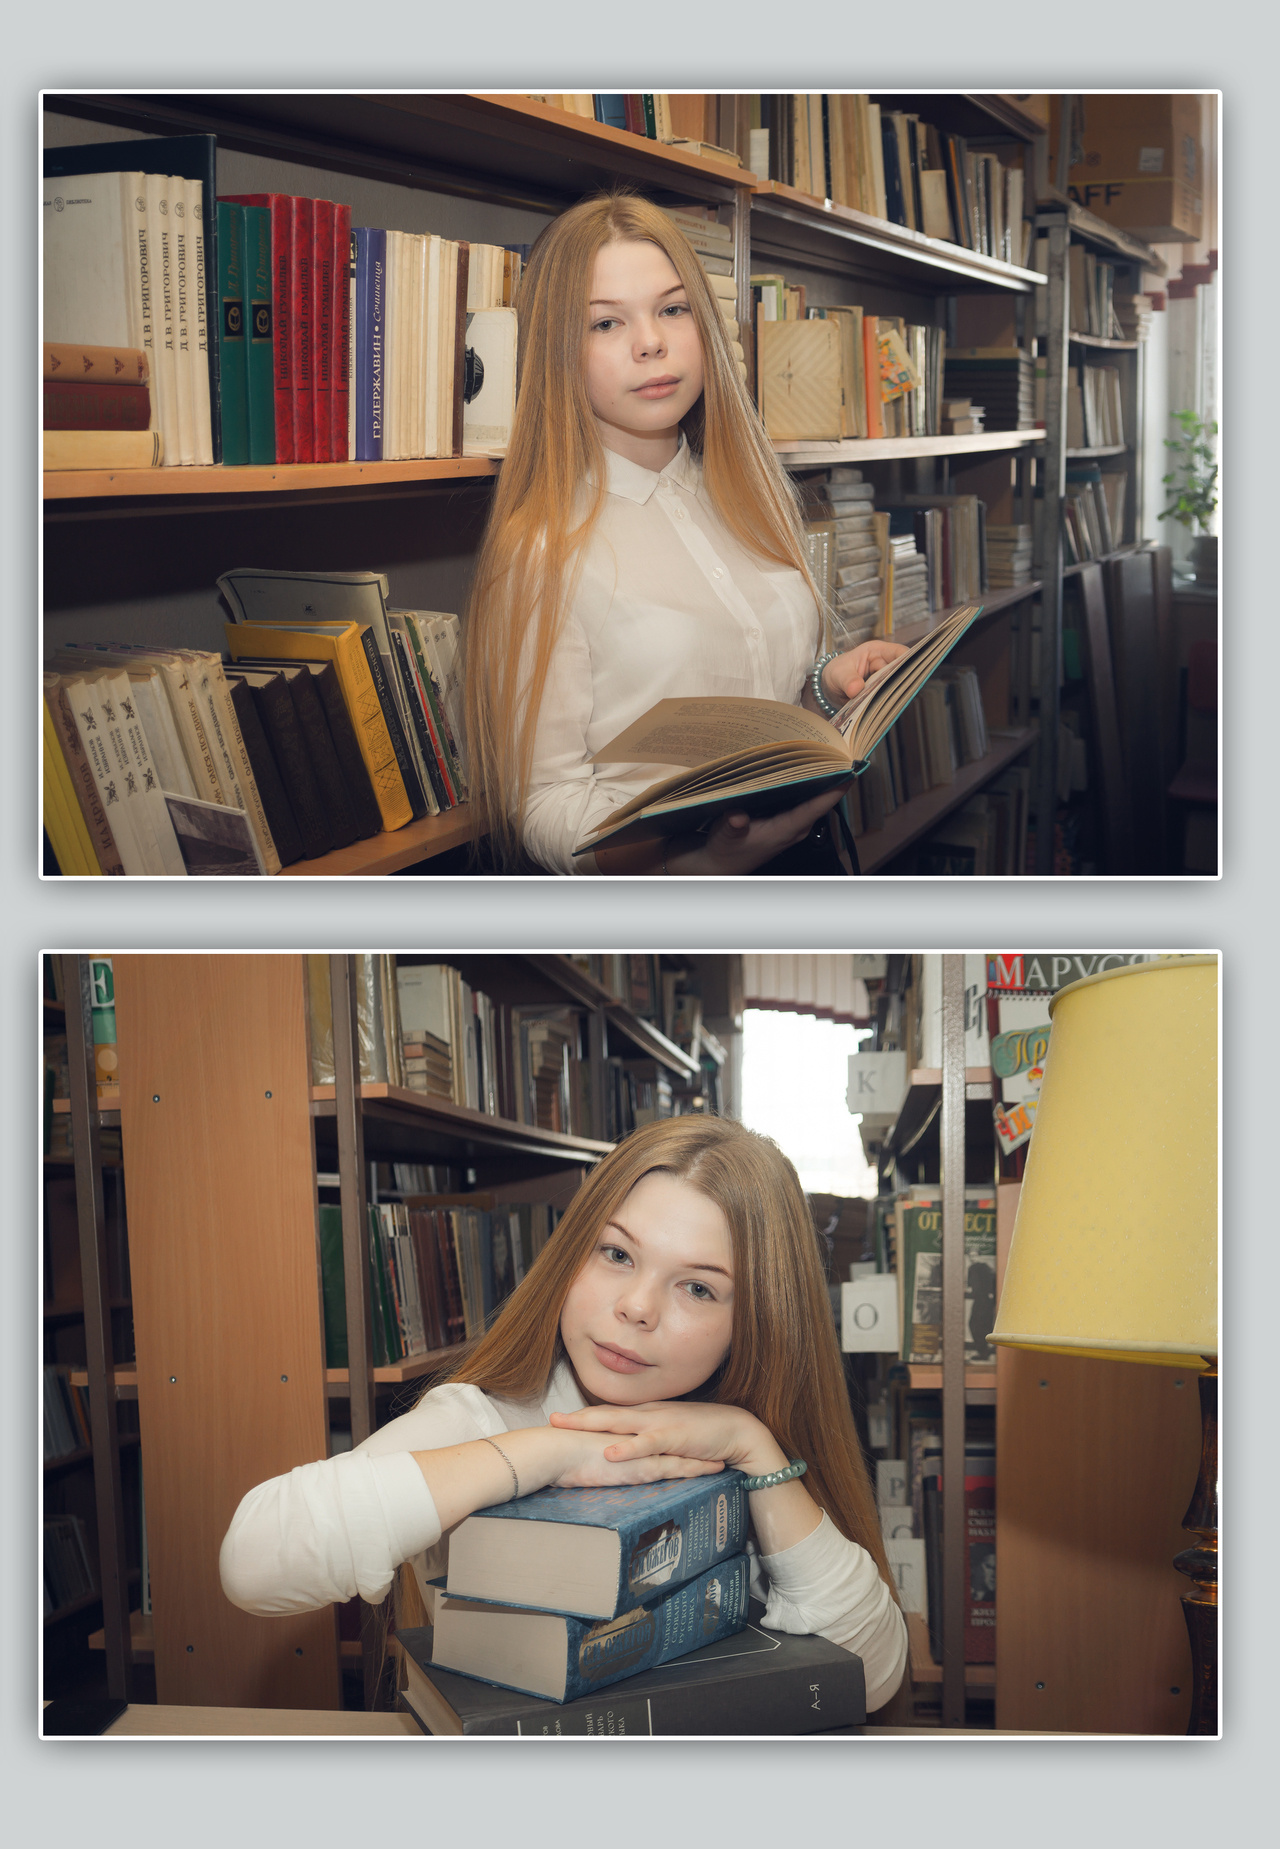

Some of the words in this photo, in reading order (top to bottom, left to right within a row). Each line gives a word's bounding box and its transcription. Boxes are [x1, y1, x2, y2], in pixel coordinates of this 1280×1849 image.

[138, 229, 151, 319] ГРИГОРОВИЧ
[161, 231, 172, 321] ГРИГОРОВИЧ
[177, 234, 187, 323] ГРИГОРОВИЧ
[196, 235, 205, 323] ГРИГОРОВИЧ
[278, 255, 290, 315] ГУМИЛЕВ
[322, 260, 330, 318] ГУМИЛЕВ
[372, 261, 382, 322] Сочинения
[276, 318, 289, 380] НИКОЛАЙ
[298, 321, 308, 381] НИКОЛАЙ
[321, 322, 329, 381] НИКОЛАЙ
[362, 636, 386, 692] Рассказы
[112, 726, 130, 765] ИЗБРАННОЕ
[131, 723, 149, 761] ИЗБРАННОЕ
[185, 697, 209, 751] ПОЕДИНОК
[93, 734, 112, 774] ИЗБРАННОЕ
[202, 753, 218, 784] ОЛЕСЯ
[238, 746, 253, 776] ОЛЕСЯ
[646, 1536, 679, 1573] ОЖЕГОВ
[686, 1508, 694, 1569] ТОЛКОВЫЙ
[718, 1525, 726, 1546] 100
[604, 1622, 653, 1658] ОЖЕГОВ
[663, 1595, 673, 1651] ТОЛКОВЫЙ
[671, 1597, 679, 1644] СЛОВАРЬ
[678, 1591, 687, 1645] РУССКОГО
[687, 1597, 695, 1632] ЯЗЫКА
